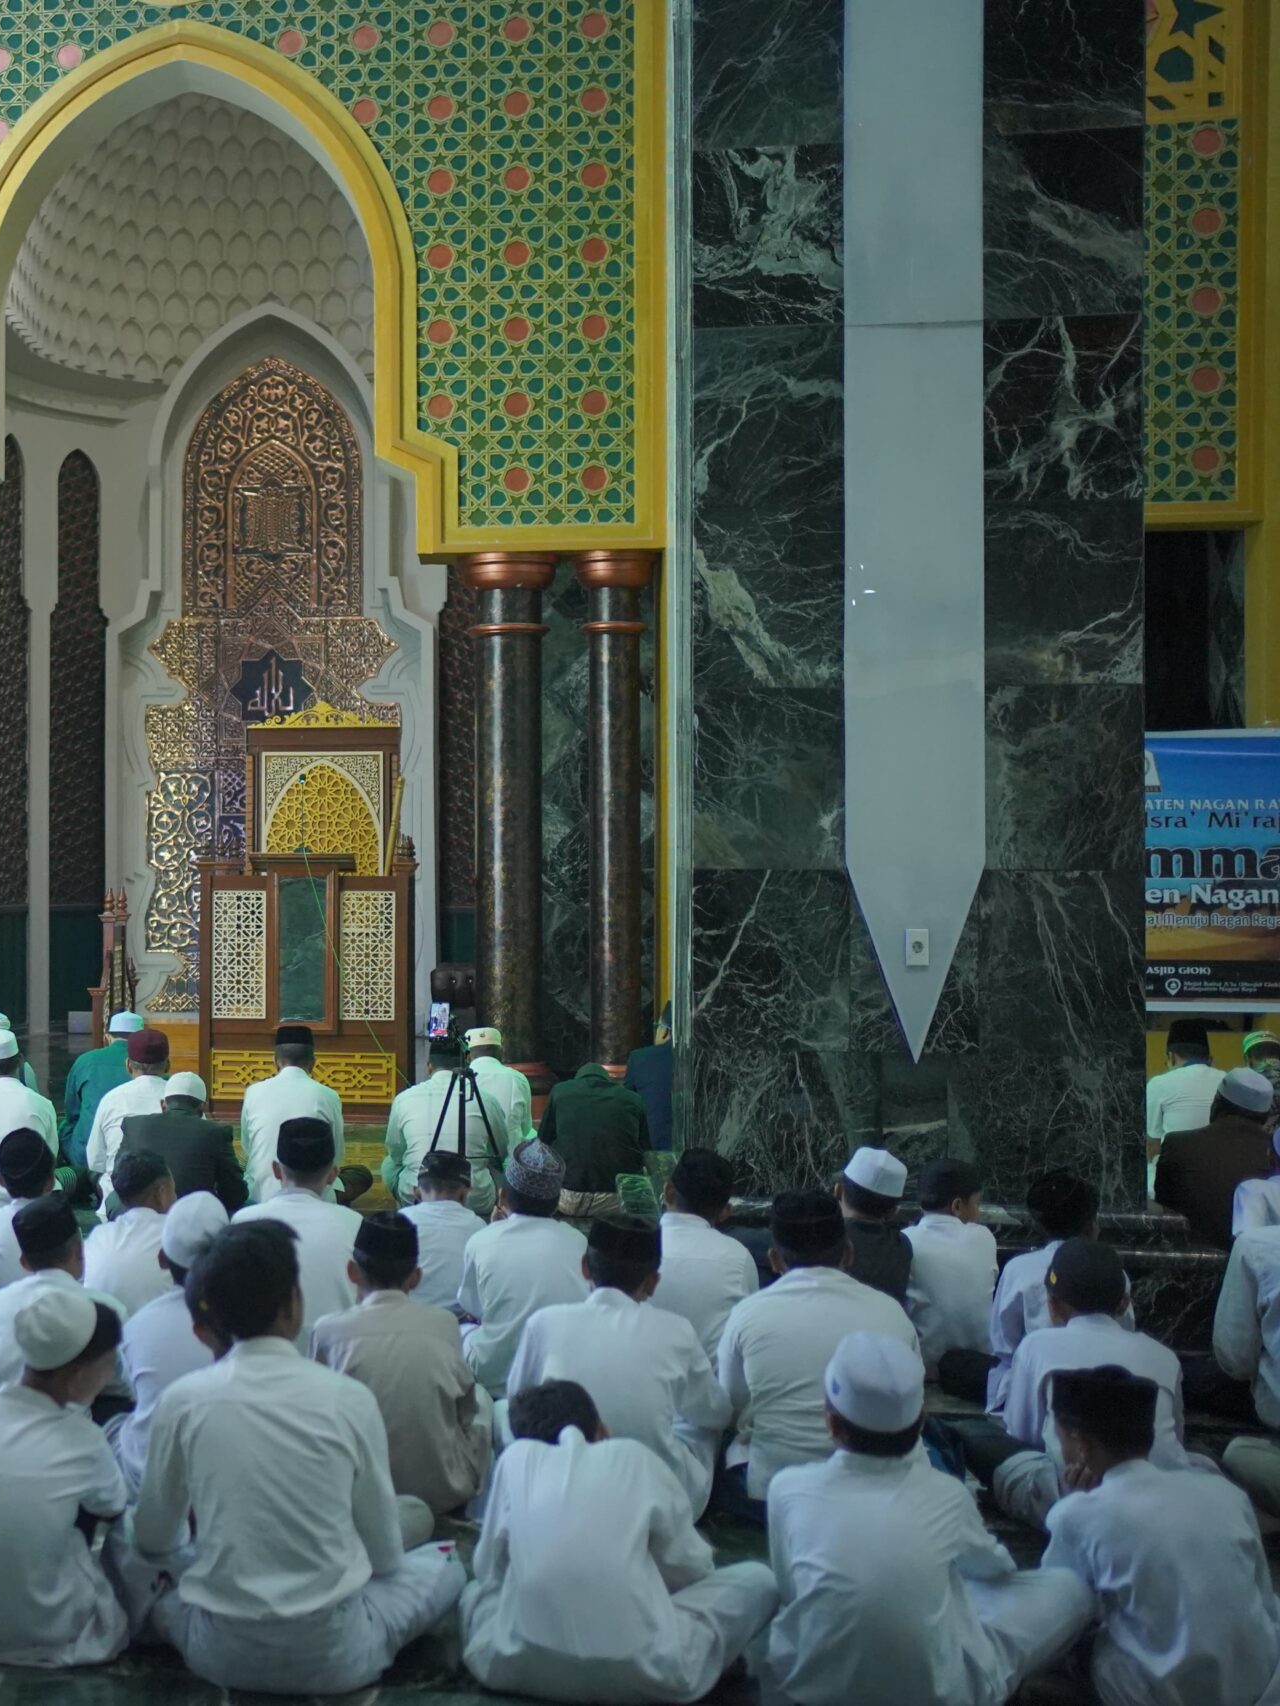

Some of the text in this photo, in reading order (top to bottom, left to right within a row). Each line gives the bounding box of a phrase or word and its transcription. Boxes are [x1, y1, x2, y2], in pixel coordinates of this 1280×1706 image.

[1190, 799, 1249, 810] NAGAN
[1145, 884, 1280, 911] en Nagan
[1163, 912, 1208, 928] Menuju
[1211, 912, 1251, 928] Nagan
